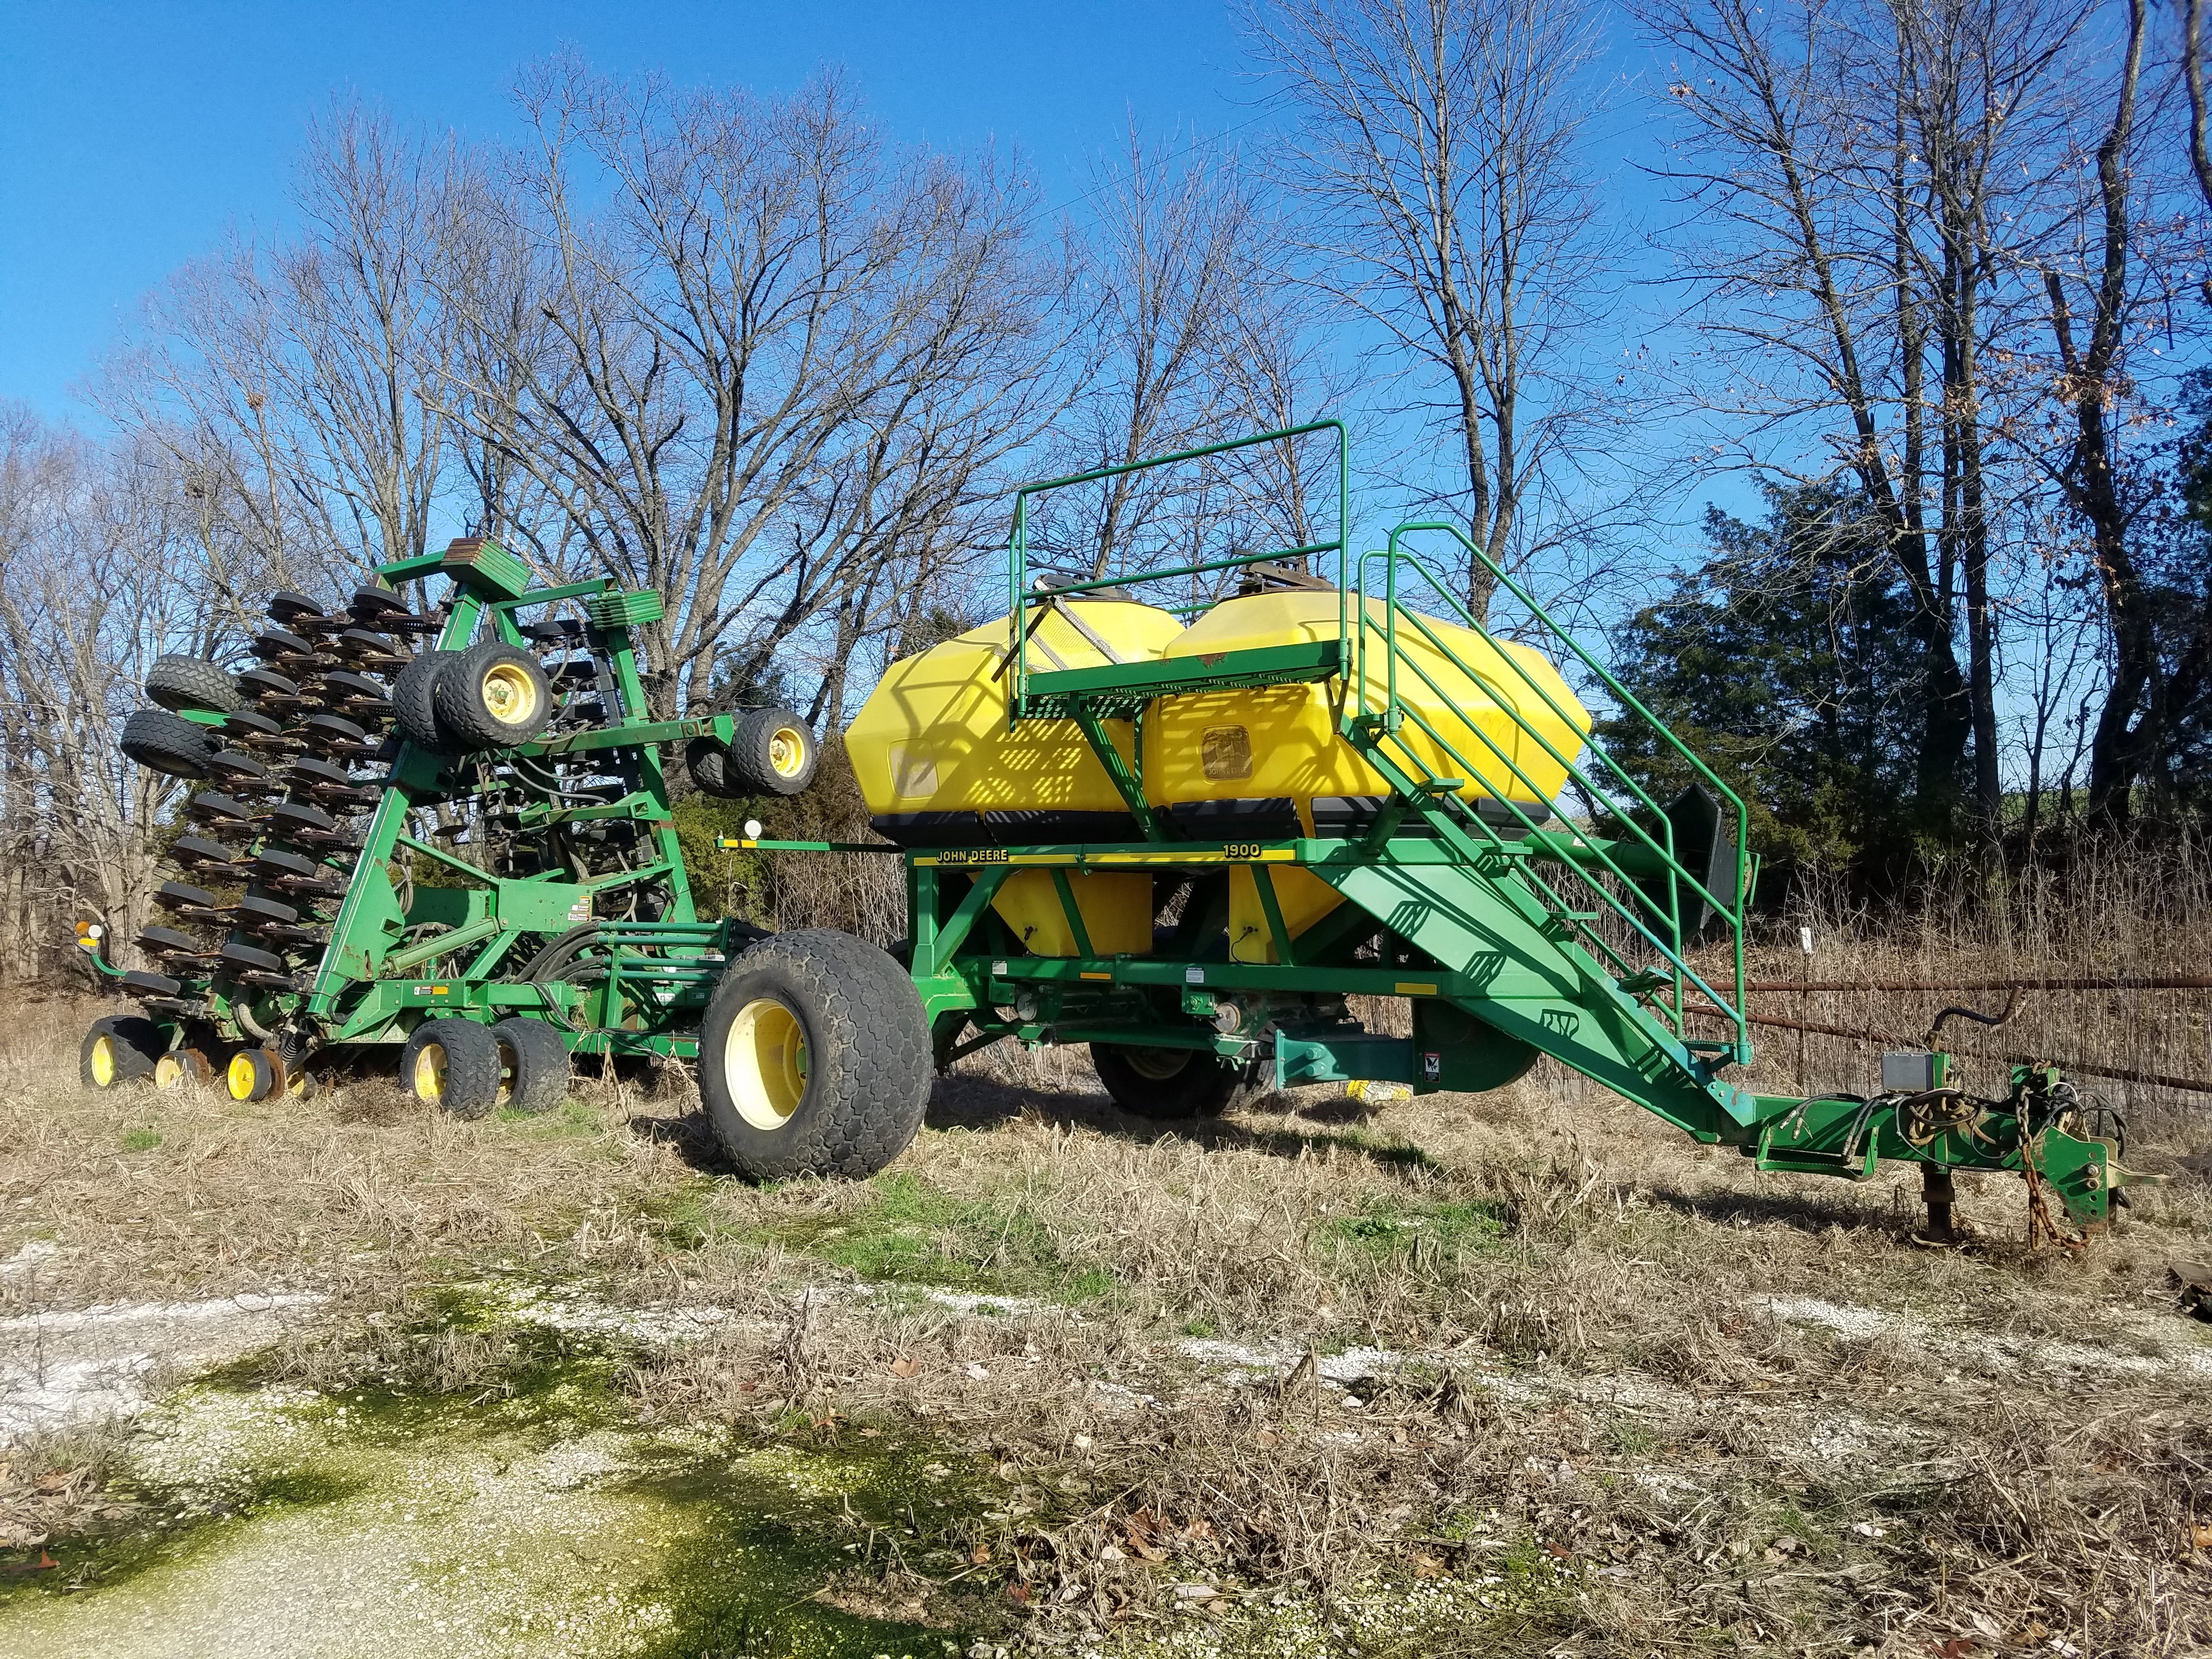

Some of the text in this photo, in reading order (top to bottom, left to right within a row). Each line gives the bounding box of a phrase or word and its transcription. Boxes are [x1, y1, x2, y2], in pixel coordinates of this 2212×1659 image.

[936, 849, 1008, 862] JOHN DEERE
[1223, 843, 1260, 857] 1900
